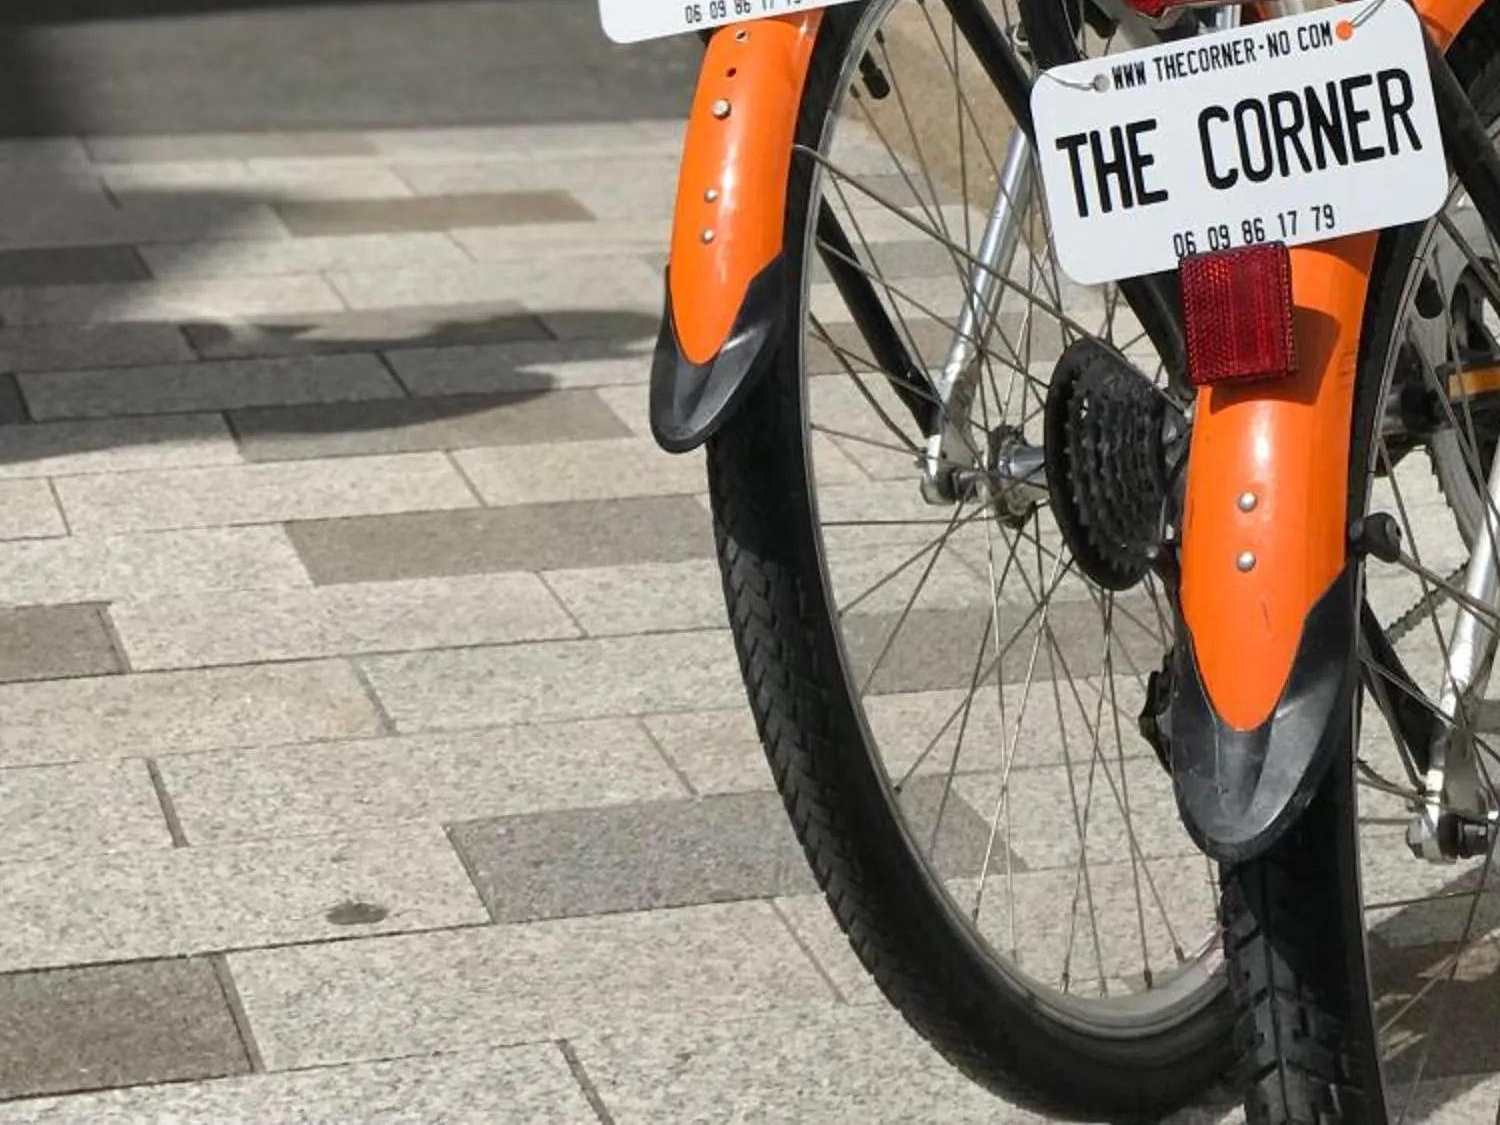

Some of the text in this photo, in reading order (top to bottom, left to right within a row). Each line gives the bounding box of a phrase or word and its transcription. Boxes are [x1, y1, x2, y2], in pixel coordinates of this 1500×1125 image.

[1111, 61, 1146, 91] WWW
[1297, 21, 1334, 53] COM
[1055, 68, 1424, 218] THE CORNER
[1173, 203, 1336, 259] 06 09 86 17 79
